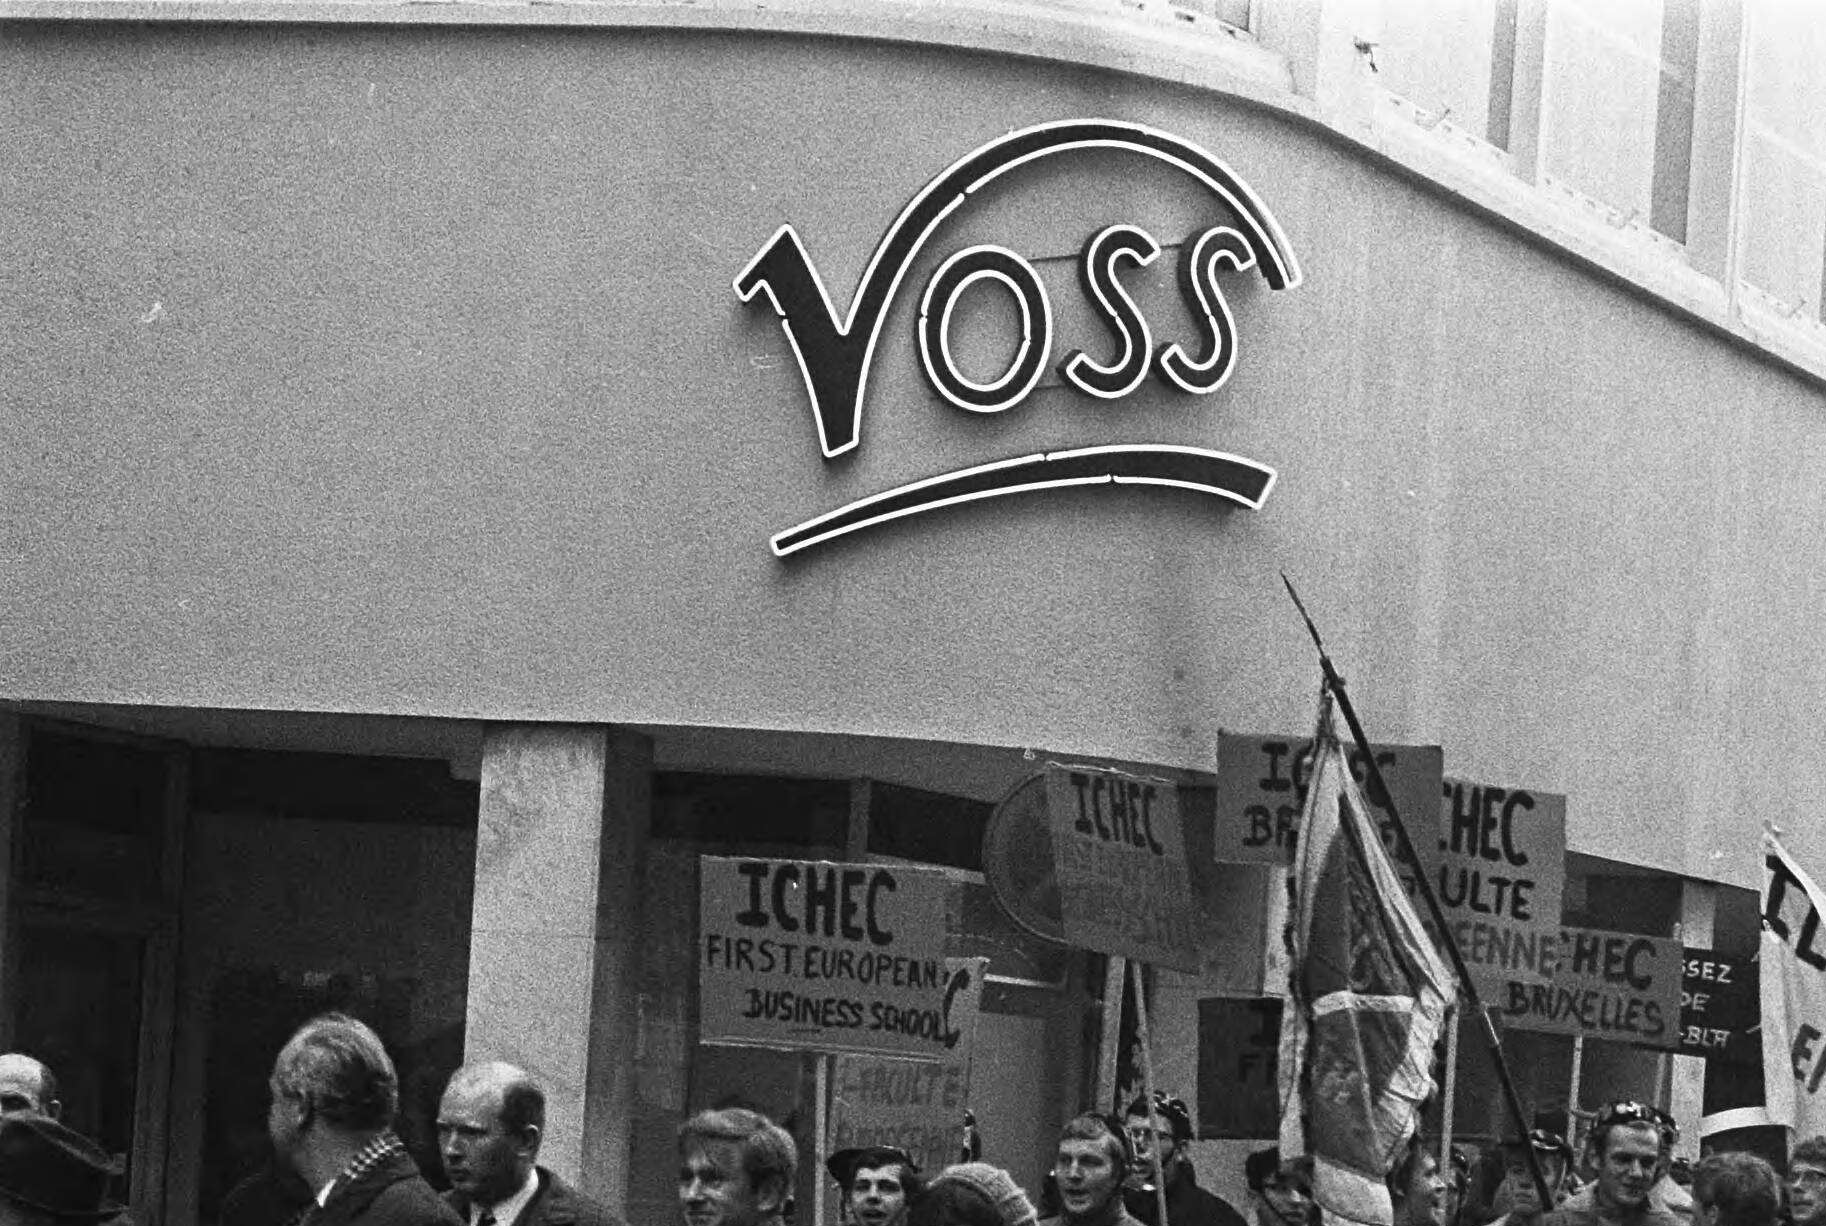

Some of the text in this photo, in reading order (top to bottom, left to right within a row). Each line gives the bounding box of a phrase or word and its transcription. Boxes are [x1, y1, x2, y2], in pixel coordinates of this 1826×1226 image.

[733, 118, 1302, 460] VOSS
[1070, 772, 1163, 856] ICHEC
[1440, 781, 1535, 866] HEC
[735, 862, 897, 946] ICHEC
[1438, 866, 1534, 921] ULTE
[706, 934, 938, 988] FIRST EUROPEAN
[1555, 930, 1656, 992] HEC
[1681, 958, 1732, 984] SSEZ
[743, 988, 864, 1029] BUSINESS
[870, 1000, 948, 1043] SCHOOL
